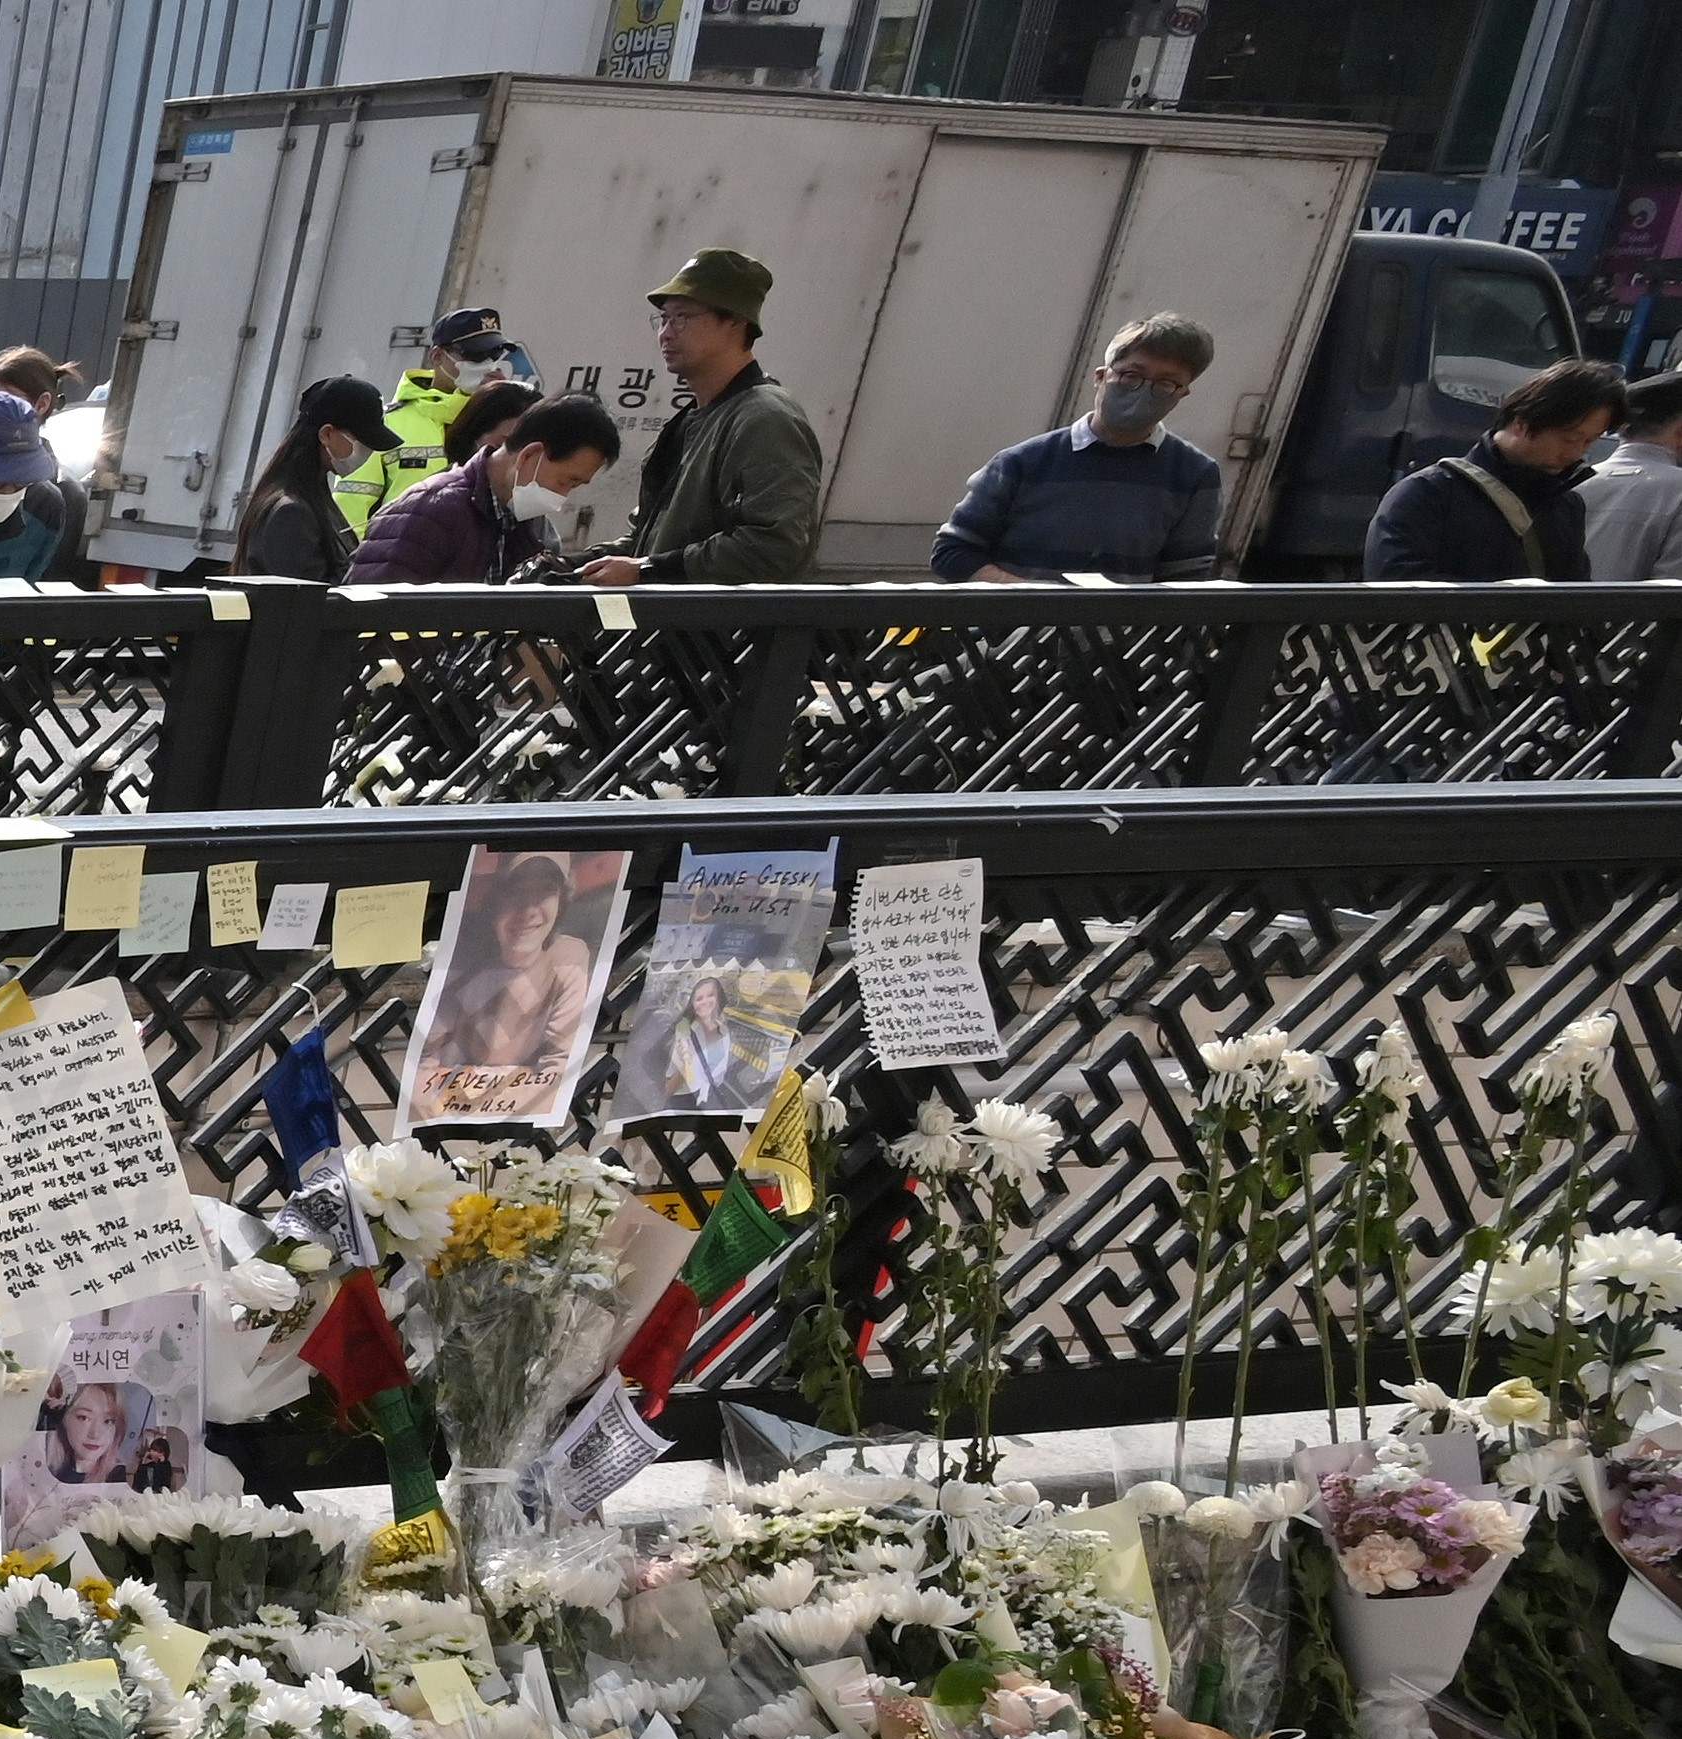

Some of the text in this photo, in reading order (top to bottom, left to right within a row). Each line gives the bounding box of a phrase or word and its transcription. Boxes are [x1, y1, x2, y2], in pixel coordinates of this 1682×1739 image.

[611, 53, 668, 78] 감자탕
[1356, 207, 1412, 234] YA
[1427, 208, 1586, 250] CFEE
[688, 866, 748, 890] ANNE
[865, 883, 963, 911] 이번 사건은 단순
[423, 1072, 505, 1094] STEVEN
[443, 1096, 471, 1112] from
[25, 1243, 33, 1254] 수
[35, 1240, 56, 1254] 없는
[141, 1236, 199, 1265] 기타리스트
[73, 1349, 129, 1370] 박시연
